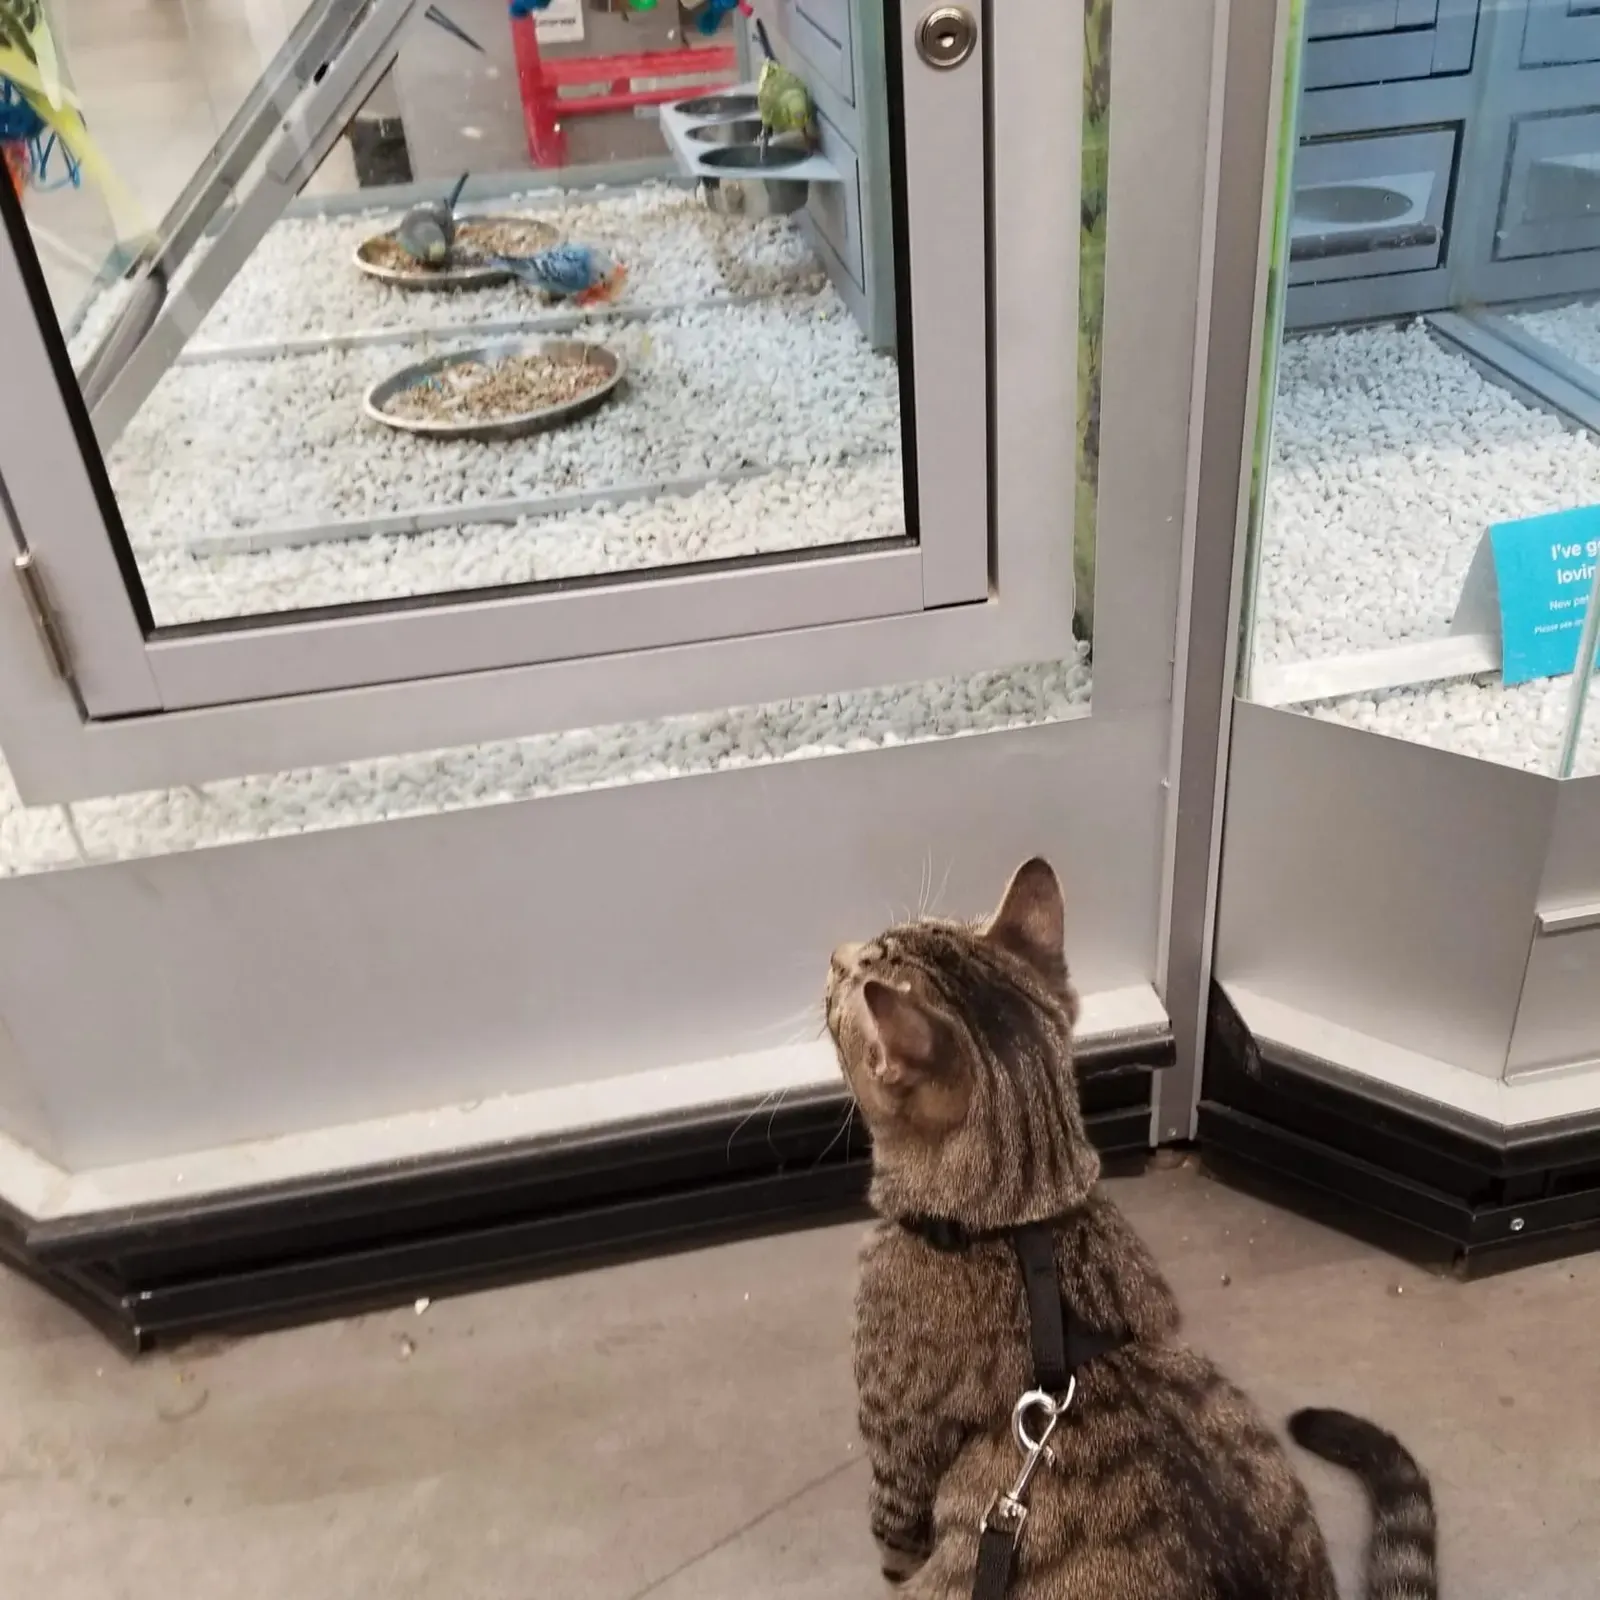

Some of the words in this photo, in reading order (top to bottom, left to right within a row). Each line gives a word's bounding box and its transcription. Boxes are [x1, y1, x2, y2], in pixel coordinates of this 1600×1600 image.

[1551, 543, 1581, 560] I've
[1550, 600, 1571, 610] New
[1534, 623, 1558, 634] Please
